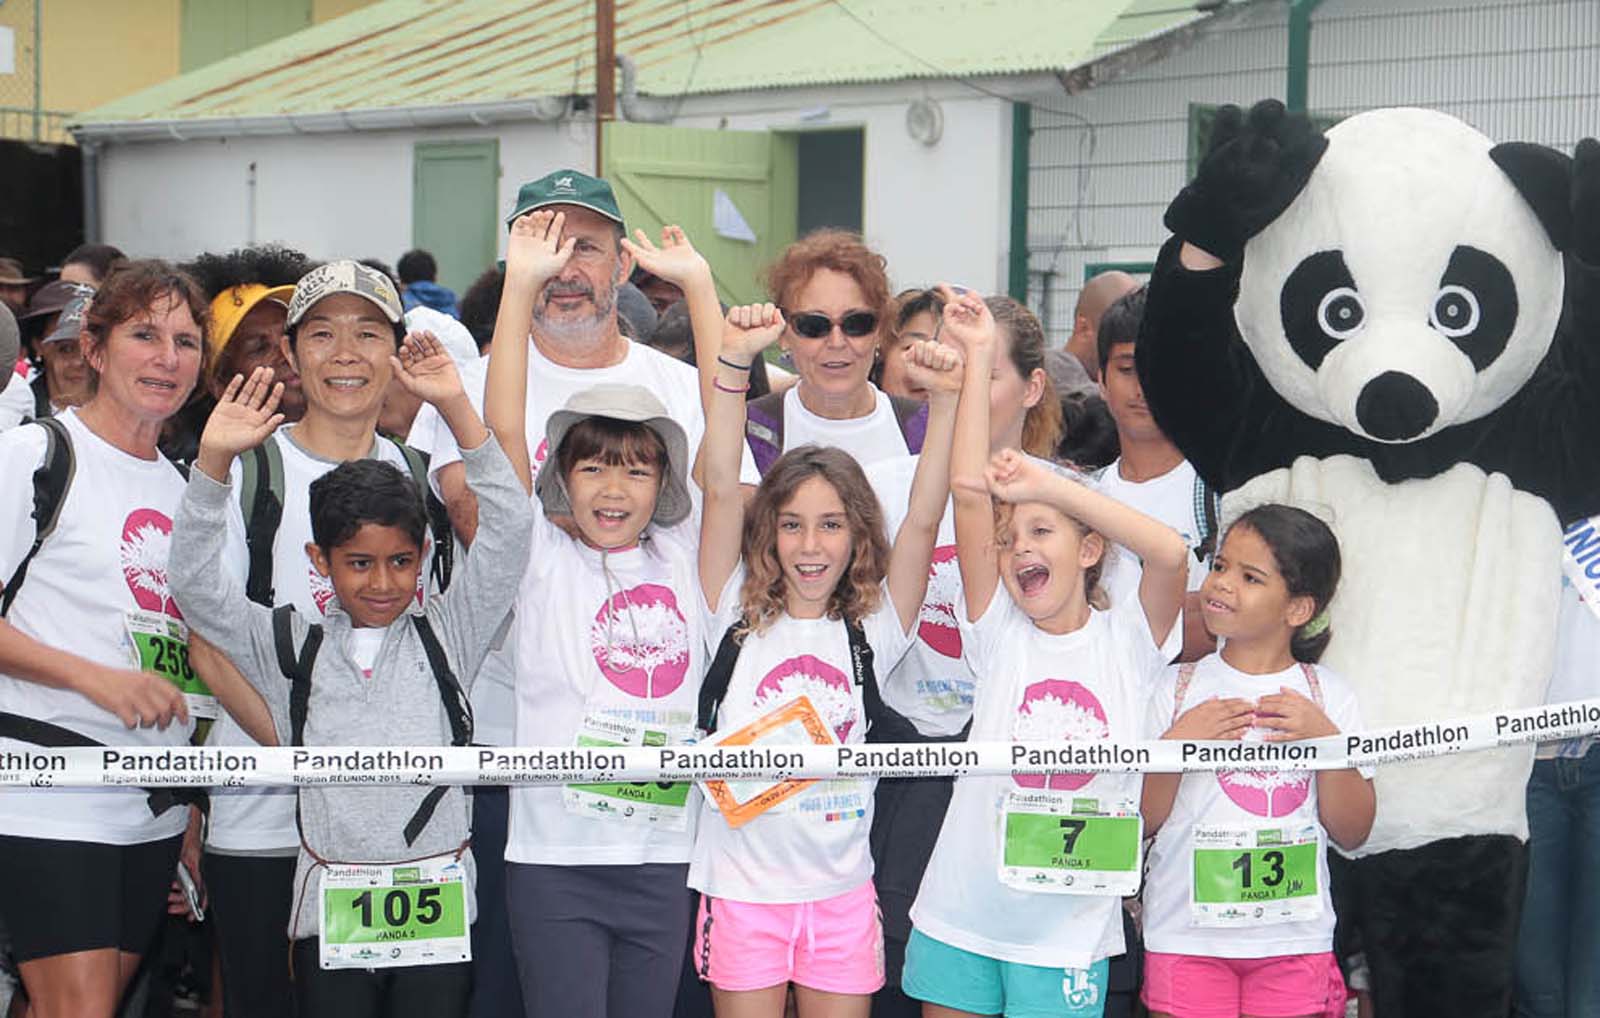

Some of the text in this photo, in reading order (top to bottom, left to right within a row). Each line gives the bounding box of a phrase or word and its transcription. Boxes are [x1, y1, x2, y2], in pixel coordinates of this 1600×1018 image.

[1563, 517, 1600, 590] NIO
[1495, 704, 1600, 736] Pandathlo
[1346, 724, 1469, 756] Pandathlon
[0, 752, 66, 770] thlon
[103, 751, 257, 770] Pandathlon
[292, 751, 444, 770] Pandathlon
[479, 750, 625, 770] Pandathlon
[659, 749, 804, 769] Pandathlon
[837, 746, 979, 767] Pandathlon
[1011, 744, 1150, 765] Pandathlon
[1182, 742, 1317, 763] Pandathlon
[379, 775, 401, 783] 2015
[617, 787, 645, 799] PANDA
[1059, 818, 1087, 855] 7
[1051, 857, 1083, 868] PANDA
[1232, 850, 1286, 888] 13
[1240, 890, 1270, 901] PANDA
[351, 887, 443, 928] 105
[376, 930, 416, 941] PANDA 5
